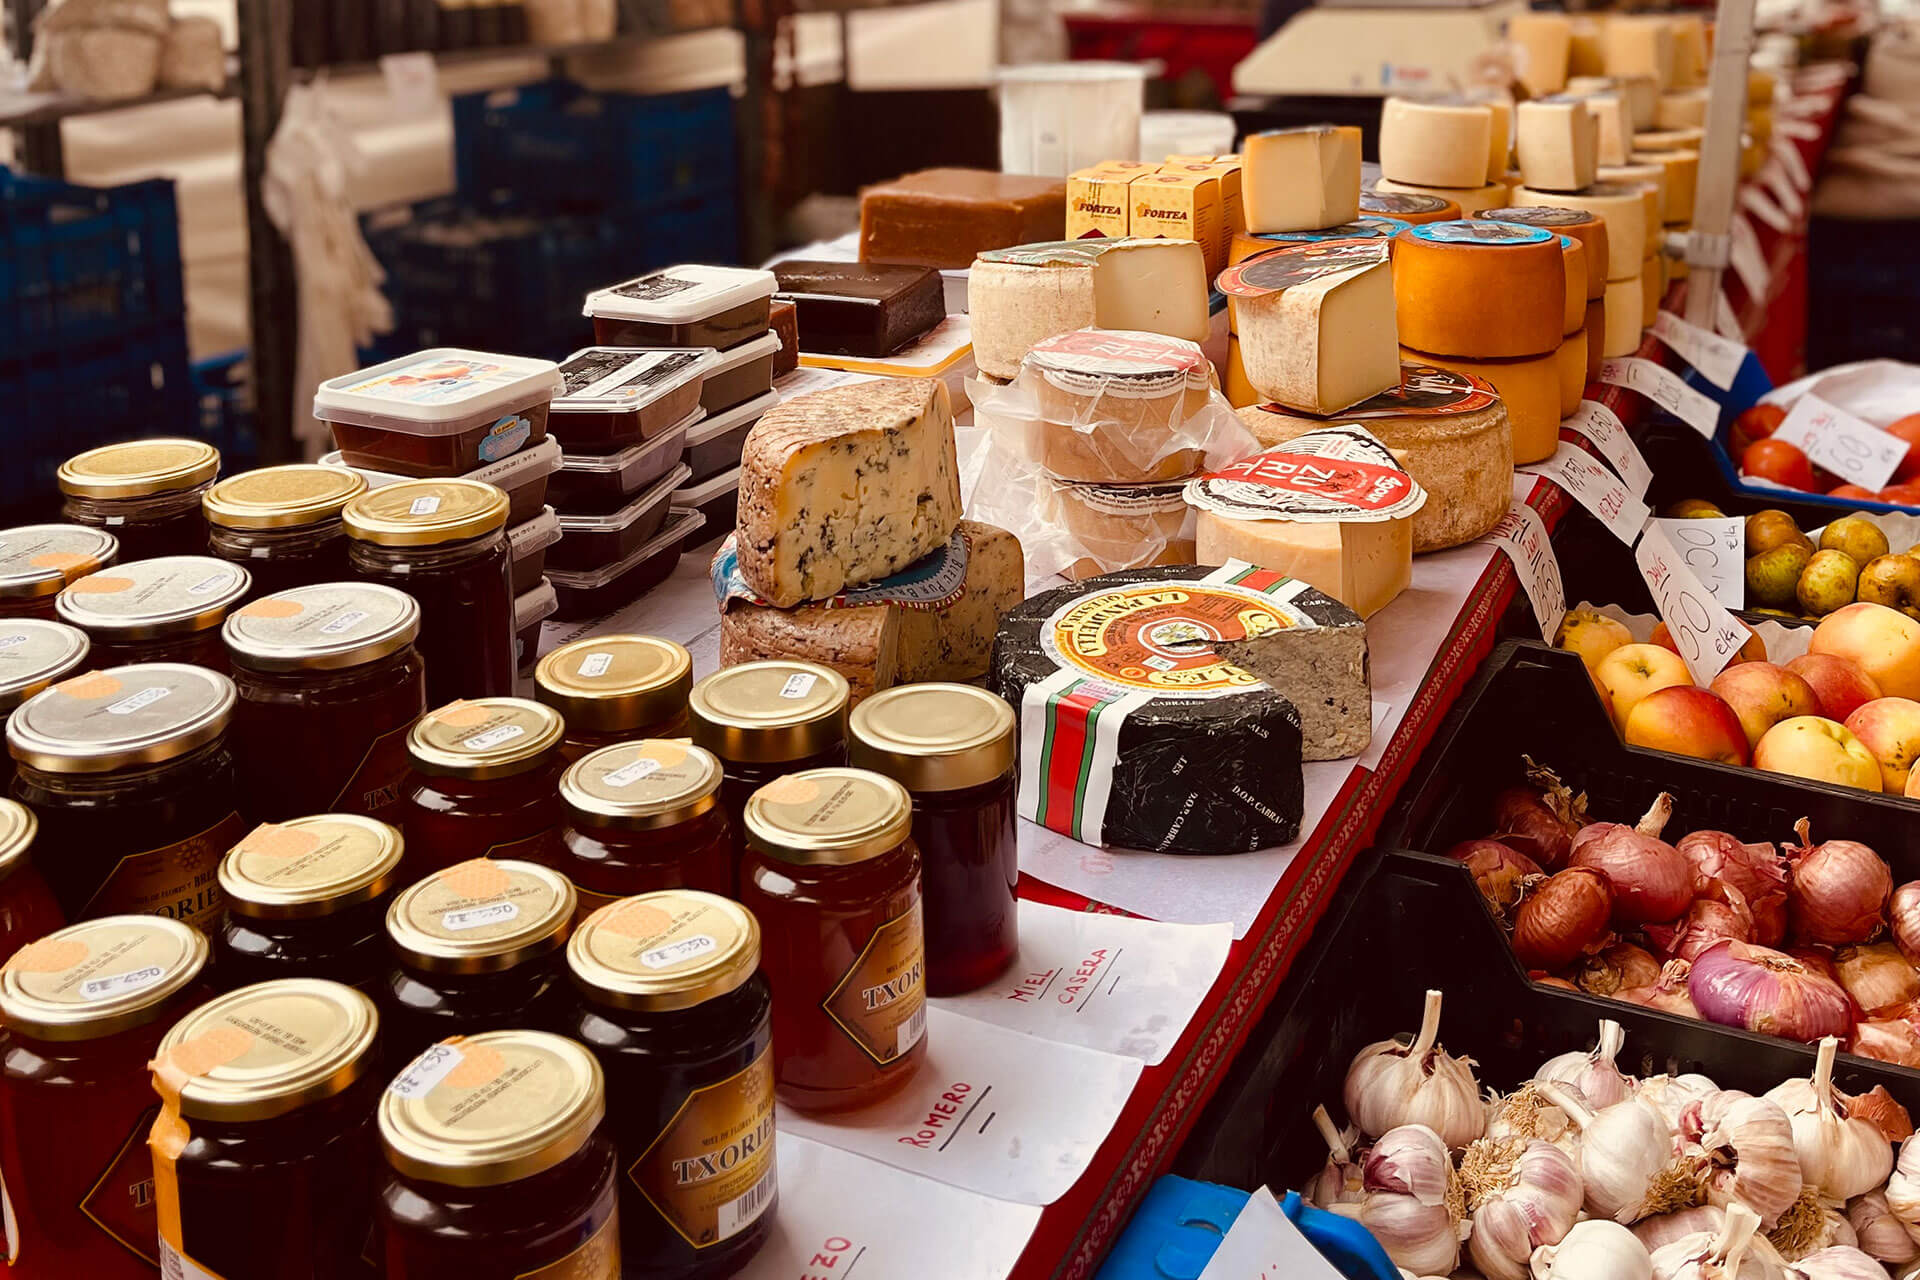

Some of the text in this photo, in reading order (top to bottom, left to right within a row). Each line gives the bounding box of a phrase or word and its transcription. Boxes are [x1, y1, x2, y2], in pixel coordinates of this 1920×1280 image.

[1079, 203, 1121, 215] FORTEA
[1143, 208, 1188, 220] FORTEA
[1289, 464, 1336, 487] ZU
[1076, 598, 1144, 654] PANDIELLA
[1008, 968, 1054, 1003] MIEL
[1057, 948, 1108, 1005] CASERA
[897, 1082, 973, 1149] ROMERO
